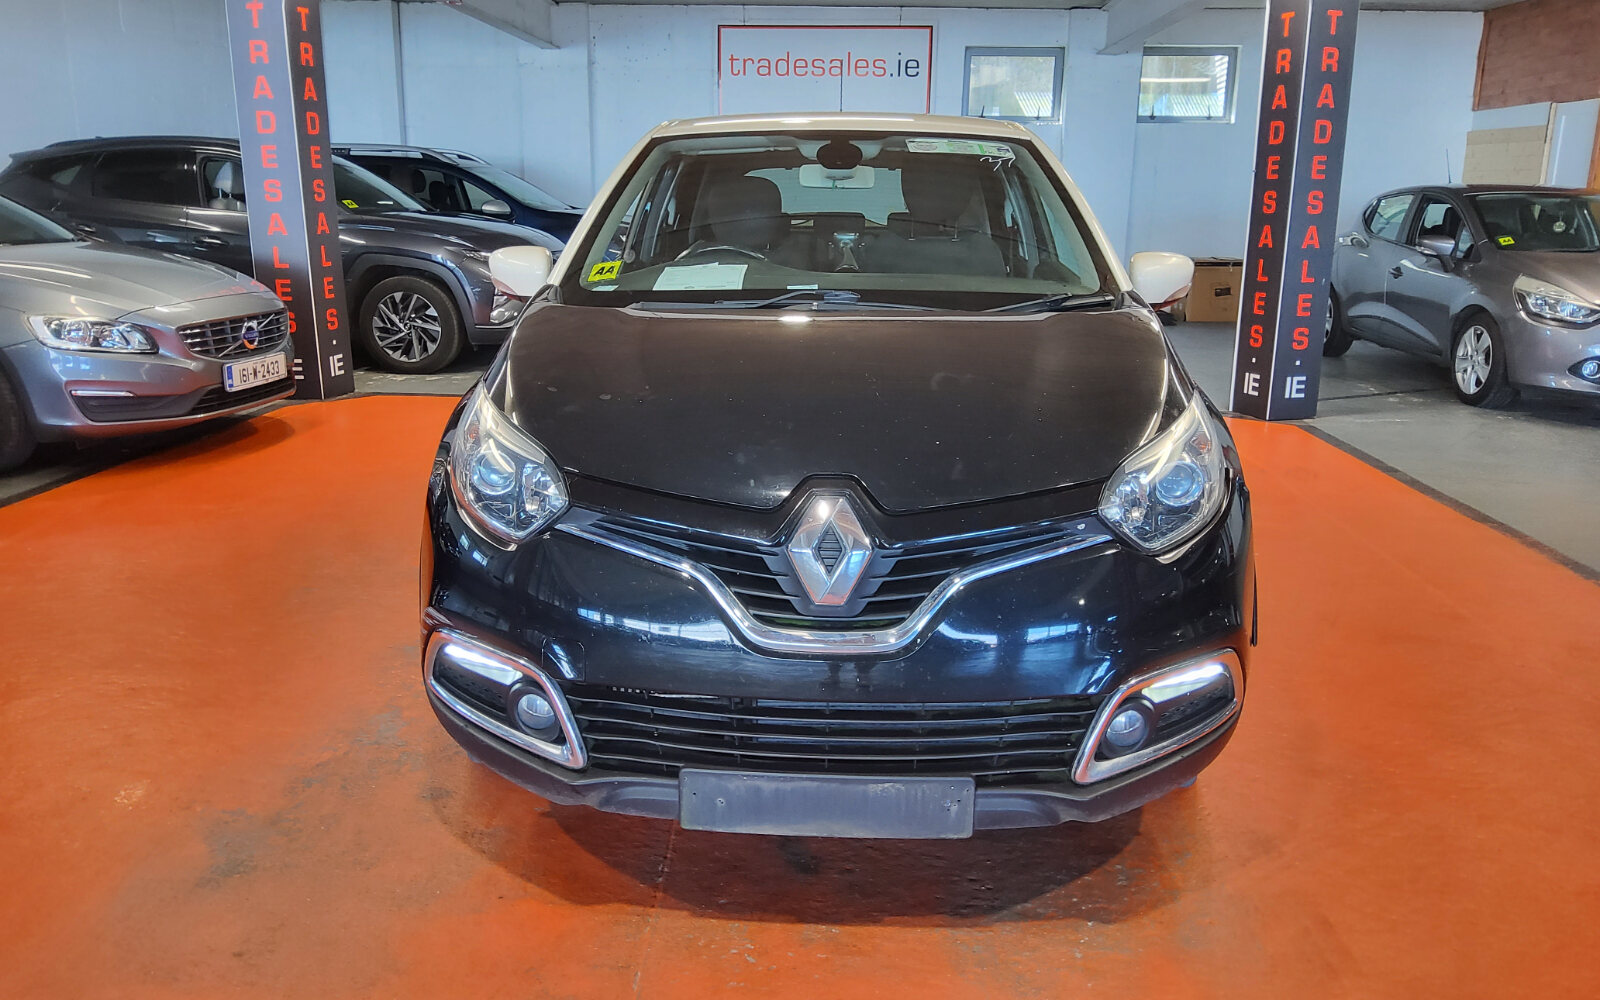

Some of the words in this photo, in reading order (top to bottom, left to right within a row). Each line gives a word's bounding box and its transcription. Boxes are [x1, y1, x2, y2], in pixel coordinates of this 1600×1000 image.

[728, 51, 920, 78] tradesales.ie
[594, 266, 615, 276] AA
[239, 360, 280, 384] 161-W-2433
